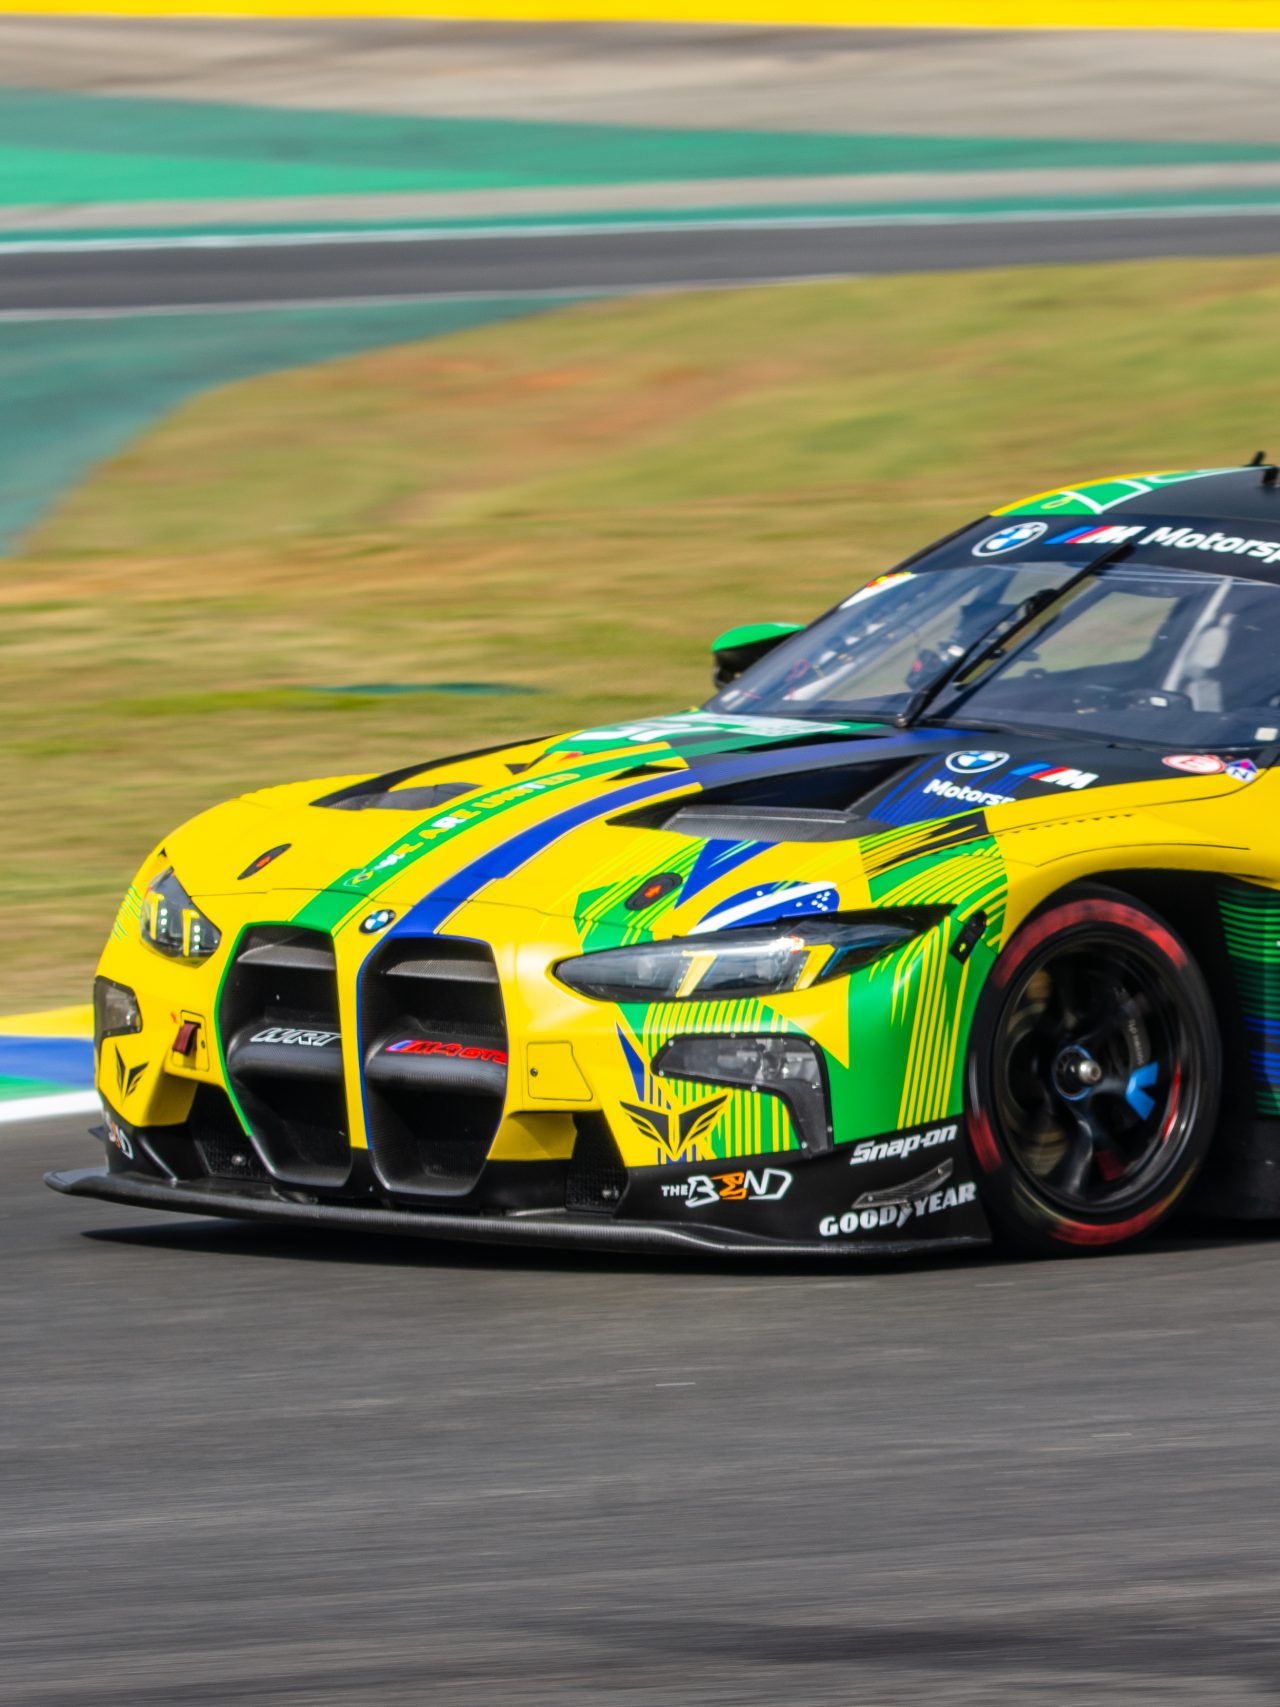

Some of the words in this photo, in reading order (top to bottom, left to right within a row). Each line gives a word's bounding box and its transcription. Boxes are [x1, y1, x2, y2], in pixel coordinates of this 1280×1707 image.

[1074, 526, 1147, 543] M
[1039, 768, 1099, 789] M
[849, 1124, 958, 1166] Snap-on
[661, 1183, 689, 1198] THE
[818, 1181, 978, 1237] GOODYEAR
